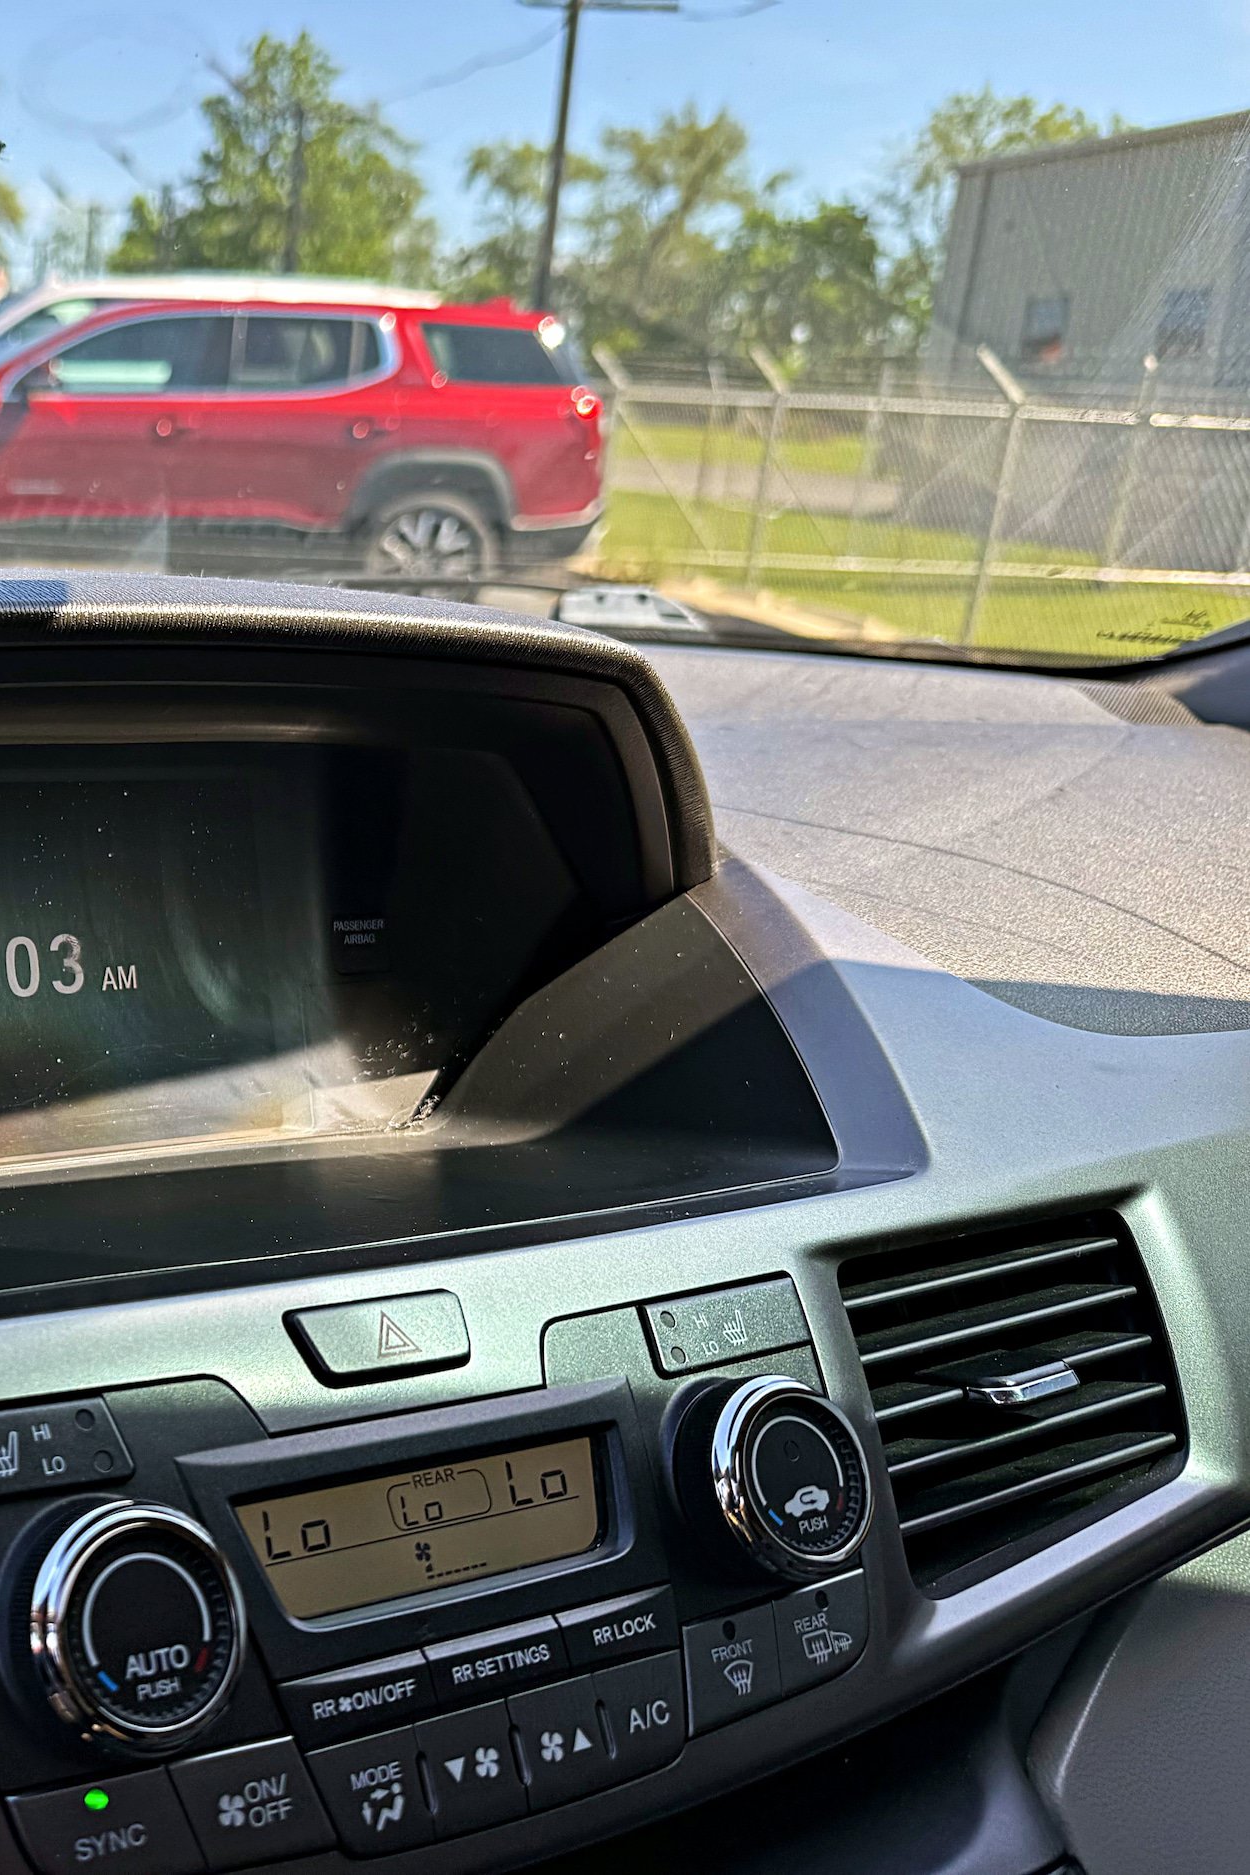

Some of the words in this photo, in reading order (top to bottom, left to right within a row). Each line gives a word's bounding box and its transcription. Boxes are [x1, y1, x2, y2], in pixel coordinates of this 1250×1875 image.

[333, 918, 384, 932] PASSENGER
[343, 933, 376, 945] AIRBAG
[5, 933, 85, 998] 03
[101, 964, 138, 992] AM
[31, 1423, 52, 1442] HI
[41, 1456, 66, 1476] LO
[413, 1467, 456, 1489] REAR
[798, 1514, 829, 1534] PUSH
[593, 1625, 615, 1647] RR
[615, 1613, 656, 1641] LOCK
[794, 1612, 828, 1635] REAR
[125, 1642, 190, 1682] AUTO
[452, 1662, 475, 1684] RR
[475, 1643, 550, 1679] SETTINGS
[711, 1638, 754, 1663] FRONT
[137, 1677, 180, 1701] PUSH
[312, 1699, 338, 1721] RR
[352, 1678, 416, 1711] ON/OFF
[628, 1699, 670, 1735] A/C
[244, 1772, 287, 1801] ON/
[350, 1761, 402, 1791] MODE
[249, 1799, 293, 1828] OFF
[74, 1823, 148, 1862] SYNC
